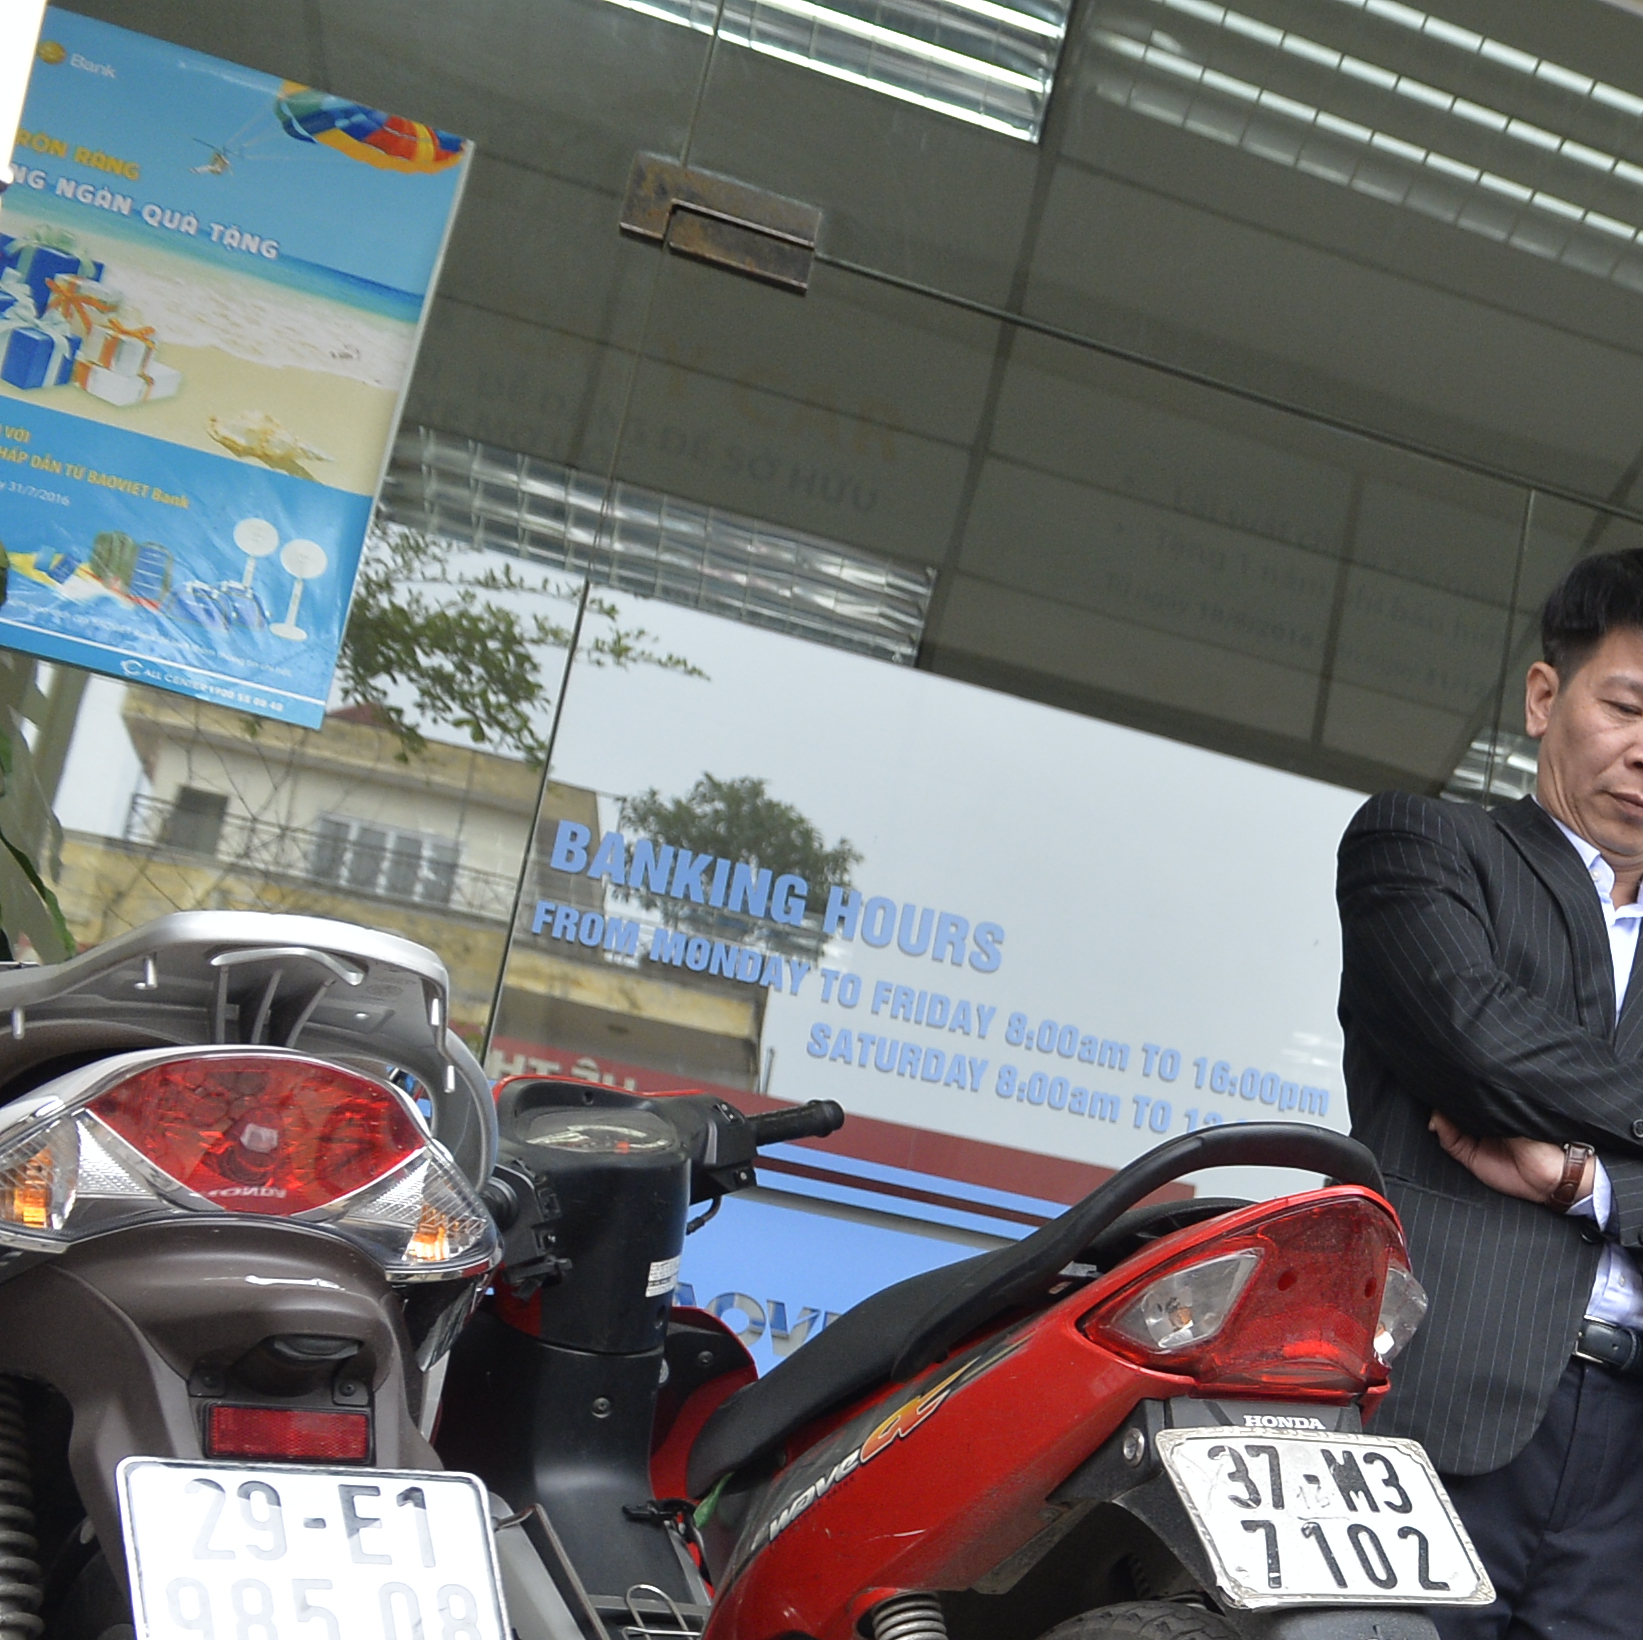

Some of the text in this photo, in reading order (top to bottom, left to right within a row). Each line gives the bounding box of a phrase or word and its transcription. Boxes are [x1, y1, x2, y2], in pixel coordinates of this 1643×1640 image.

[69, 52, 117, 78] Bank
[55, 176, 132, 216] NGÀN
[87, 470, 150, 498] BAOVIET
[151, 486, 190, 510] Bank
[549, 820, 1004, 974] BANKING HOURS
[531, 900, 1330, 1117] FROM MONDAY TO FRIDAY 8:00am TO 16:00pm
[807, 1022, 989, 1094] SATURDAY
[996, 1065, 1121, 1125] 8:00am
[1132, 1094, 1173, 1133] TO
[1243, 1414, 1326, 1431] HONDA
[1207, 1444, 1414, 1515] 37-M3
[185, 1478, 437, 1568] 29-E1
[1240, 1519, 1451, 1592] 7102
